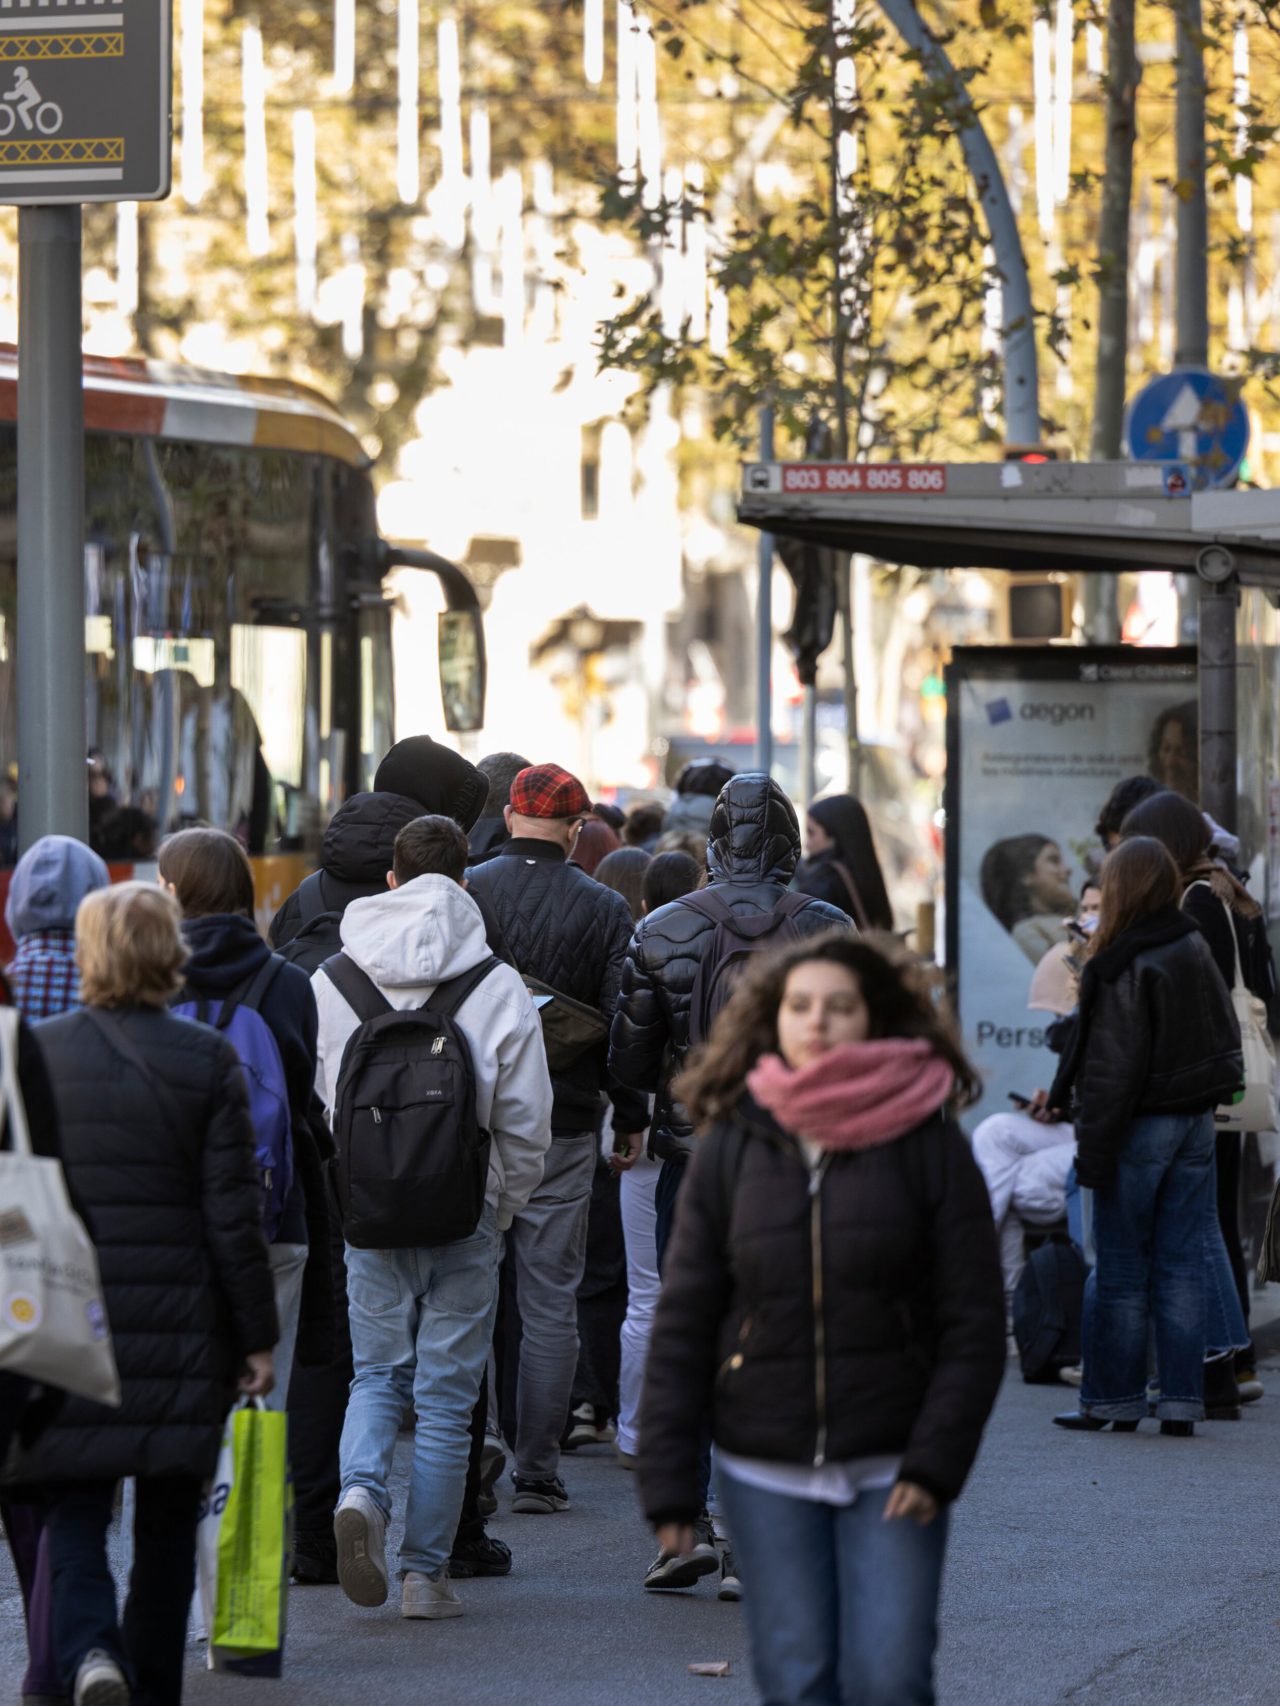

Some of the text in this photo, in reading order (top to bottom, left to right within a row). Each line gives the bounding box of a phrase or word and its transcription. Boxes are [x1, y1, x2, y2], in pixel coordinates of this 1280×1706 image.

[785, 468, 944, 490] 803 804 805 806
[1020, 702, 1095, 727] aegon
